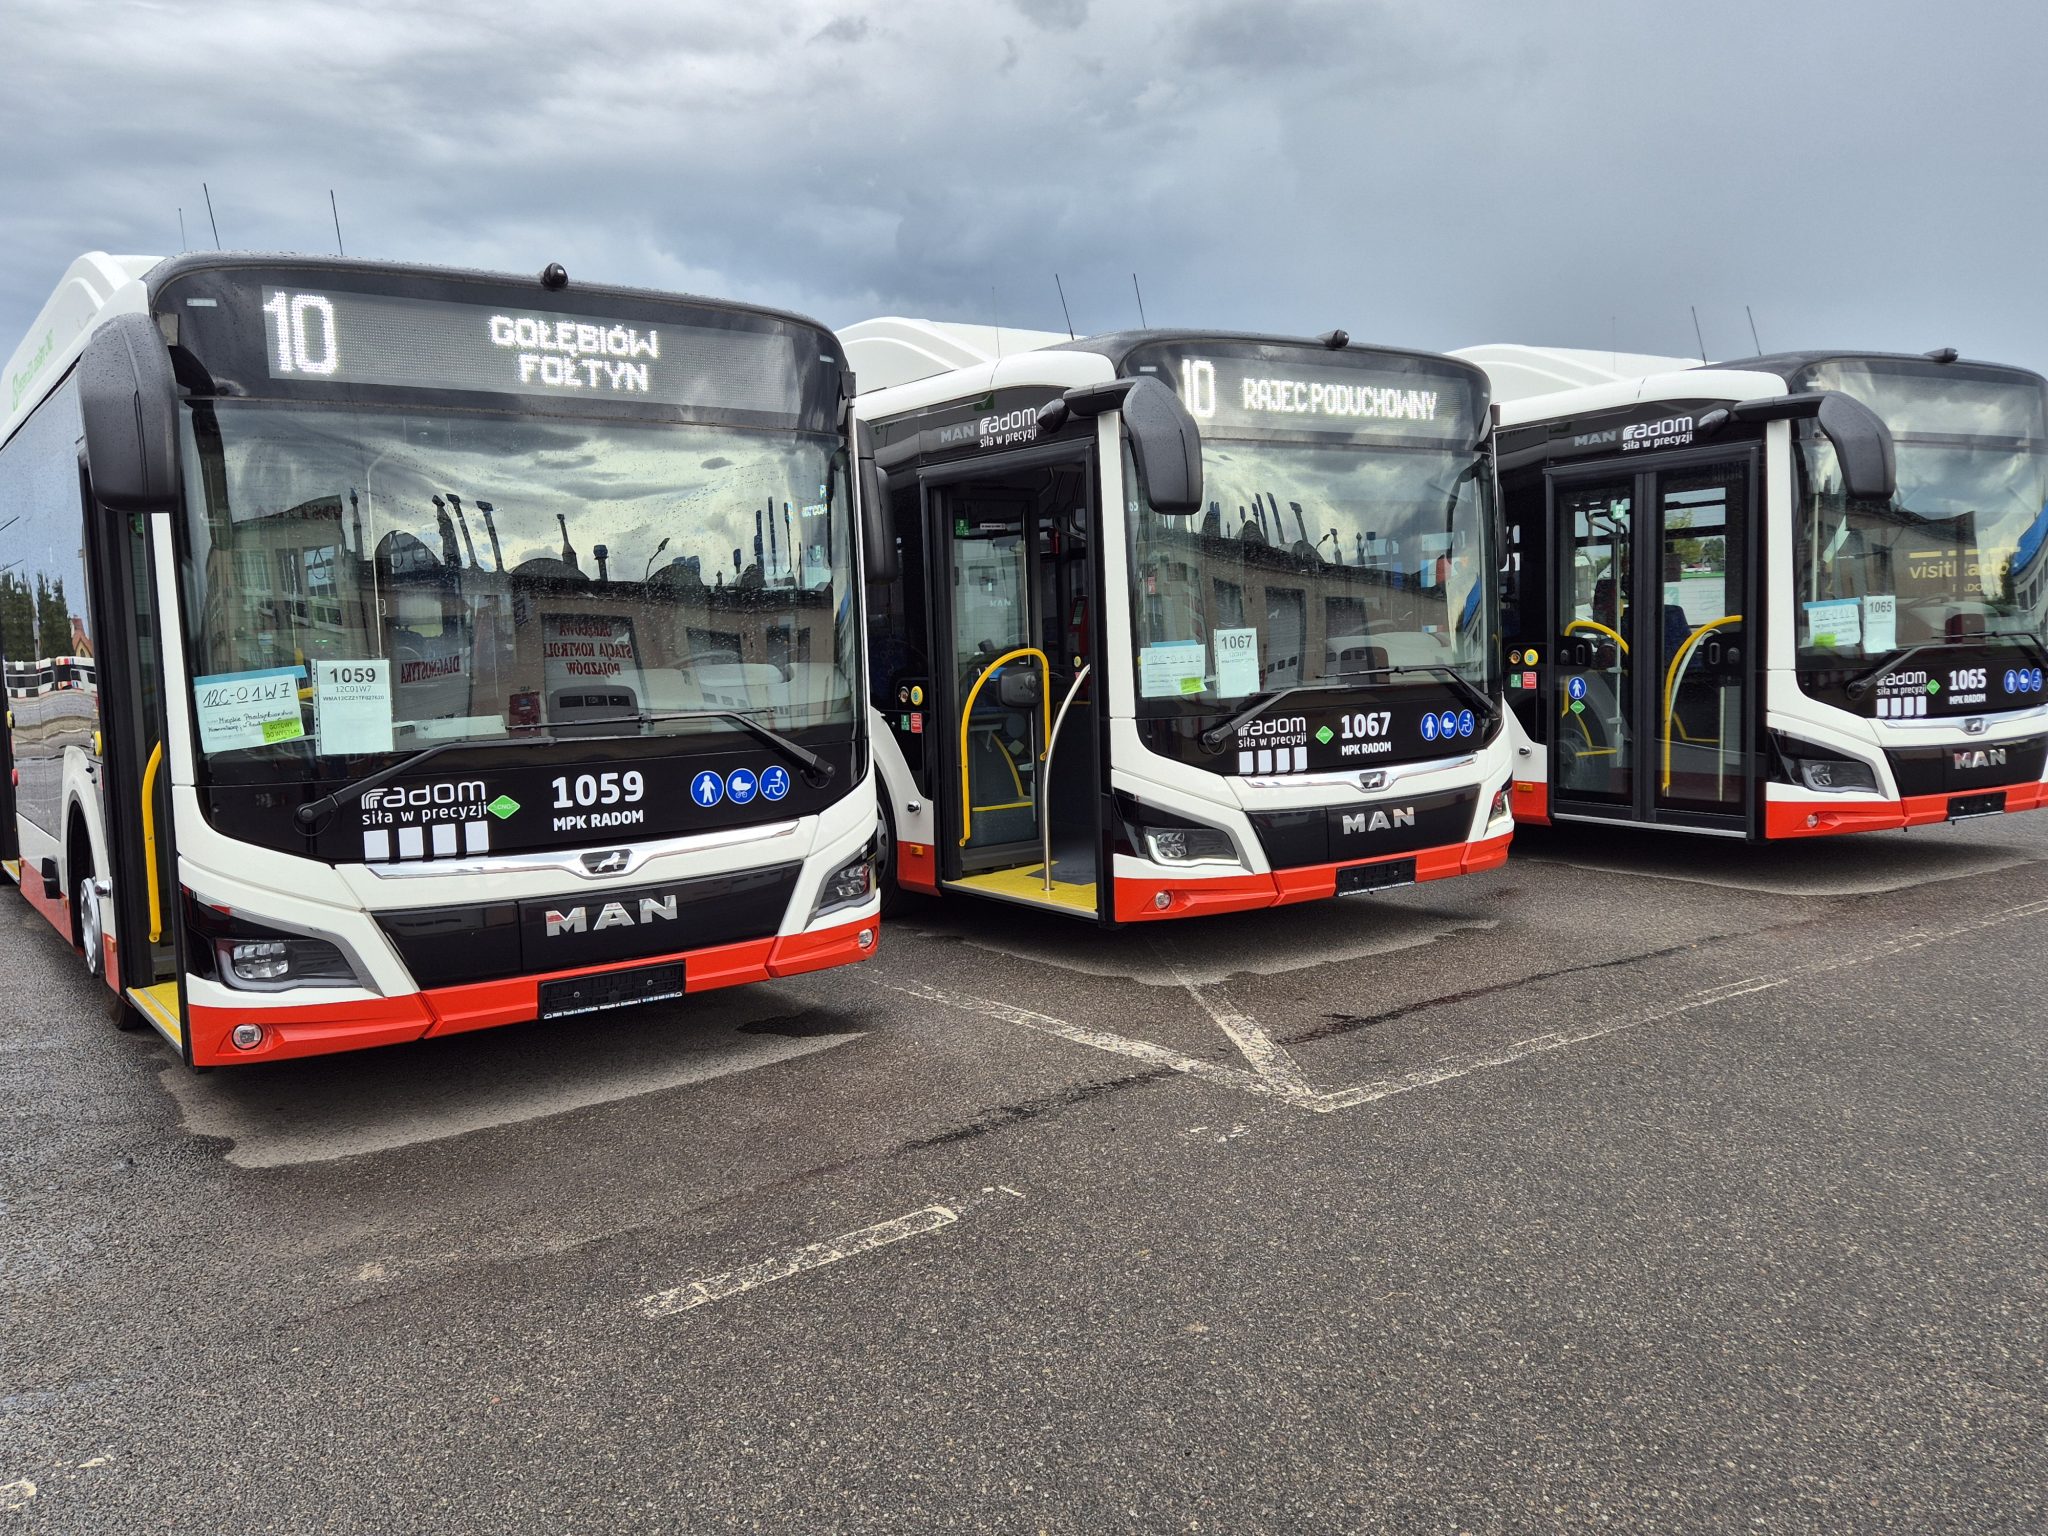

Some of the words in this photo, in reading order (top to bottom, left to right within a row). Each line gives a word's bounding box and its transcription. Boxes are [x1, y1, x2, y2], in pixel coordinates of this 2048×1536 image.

[263, 290, 338, 376] 10
[488, 314, 661, 358] GOŁĘBIÓW
[518, 353, 649, 392] FOŁTYN
[1181, 358, 1217, 418] 10
[1309, 382, 1438, 420] PODUCHOWNY
[979, 407, 1036, 435] radom
[1622, 416, 1693, 440] radom
[941, 424, 975, 443] MAN
[980, 434, 994, 448] siła
[996, 434, 1003, 445] w
[1005, 425, 1037, 446] precyzji
[1574, 430, 1617, 447] MAN
[1622, 439, 1640, 451] siła
[1642, 439, 1651, 448] w
[1653, 431, 1693, 448] precyzji
[1869, 601, 1893, 613] 1065
[1221, 634, 1253, 650] 1067
[329, 667, 376, 683] 1059
[1949, 668, 1987, 691] 1065
[1876, 686, 1891, 696] siła
[1892, 687, 1899, 695] w
[1900, 685, 1927, 697] precyzji
[1949, 697, 1963, 705] MPK
[1964, 694, 1986, 703] RADOM
[1238, 716, 1306, 736] radom
[1341, 712, 1391, 739] 1067
[1238, 736, 1256, 748] siła
[1259, 738, 1267, 746] w
[1271, 733, 1307, 747] precyzji
[1341, 745, 1360, 756] MPK
[1362, 741, 1392, 754] RADOM
[1954, 748, 2006, 769] MAN
[361, 780, 486, 810] radom
[551, 770, 644, 808] 1059
[362, 810, 393, 825] siła
[401, 811, 414, 822] w
[422, 801, 488, 823] precyzji
[553, 817, 587, 831] MPK
[591, 810, 644, 827] RADOM
[1342, 806, 1415, 835] MAN
[545, 894, 678, 937] MAN
